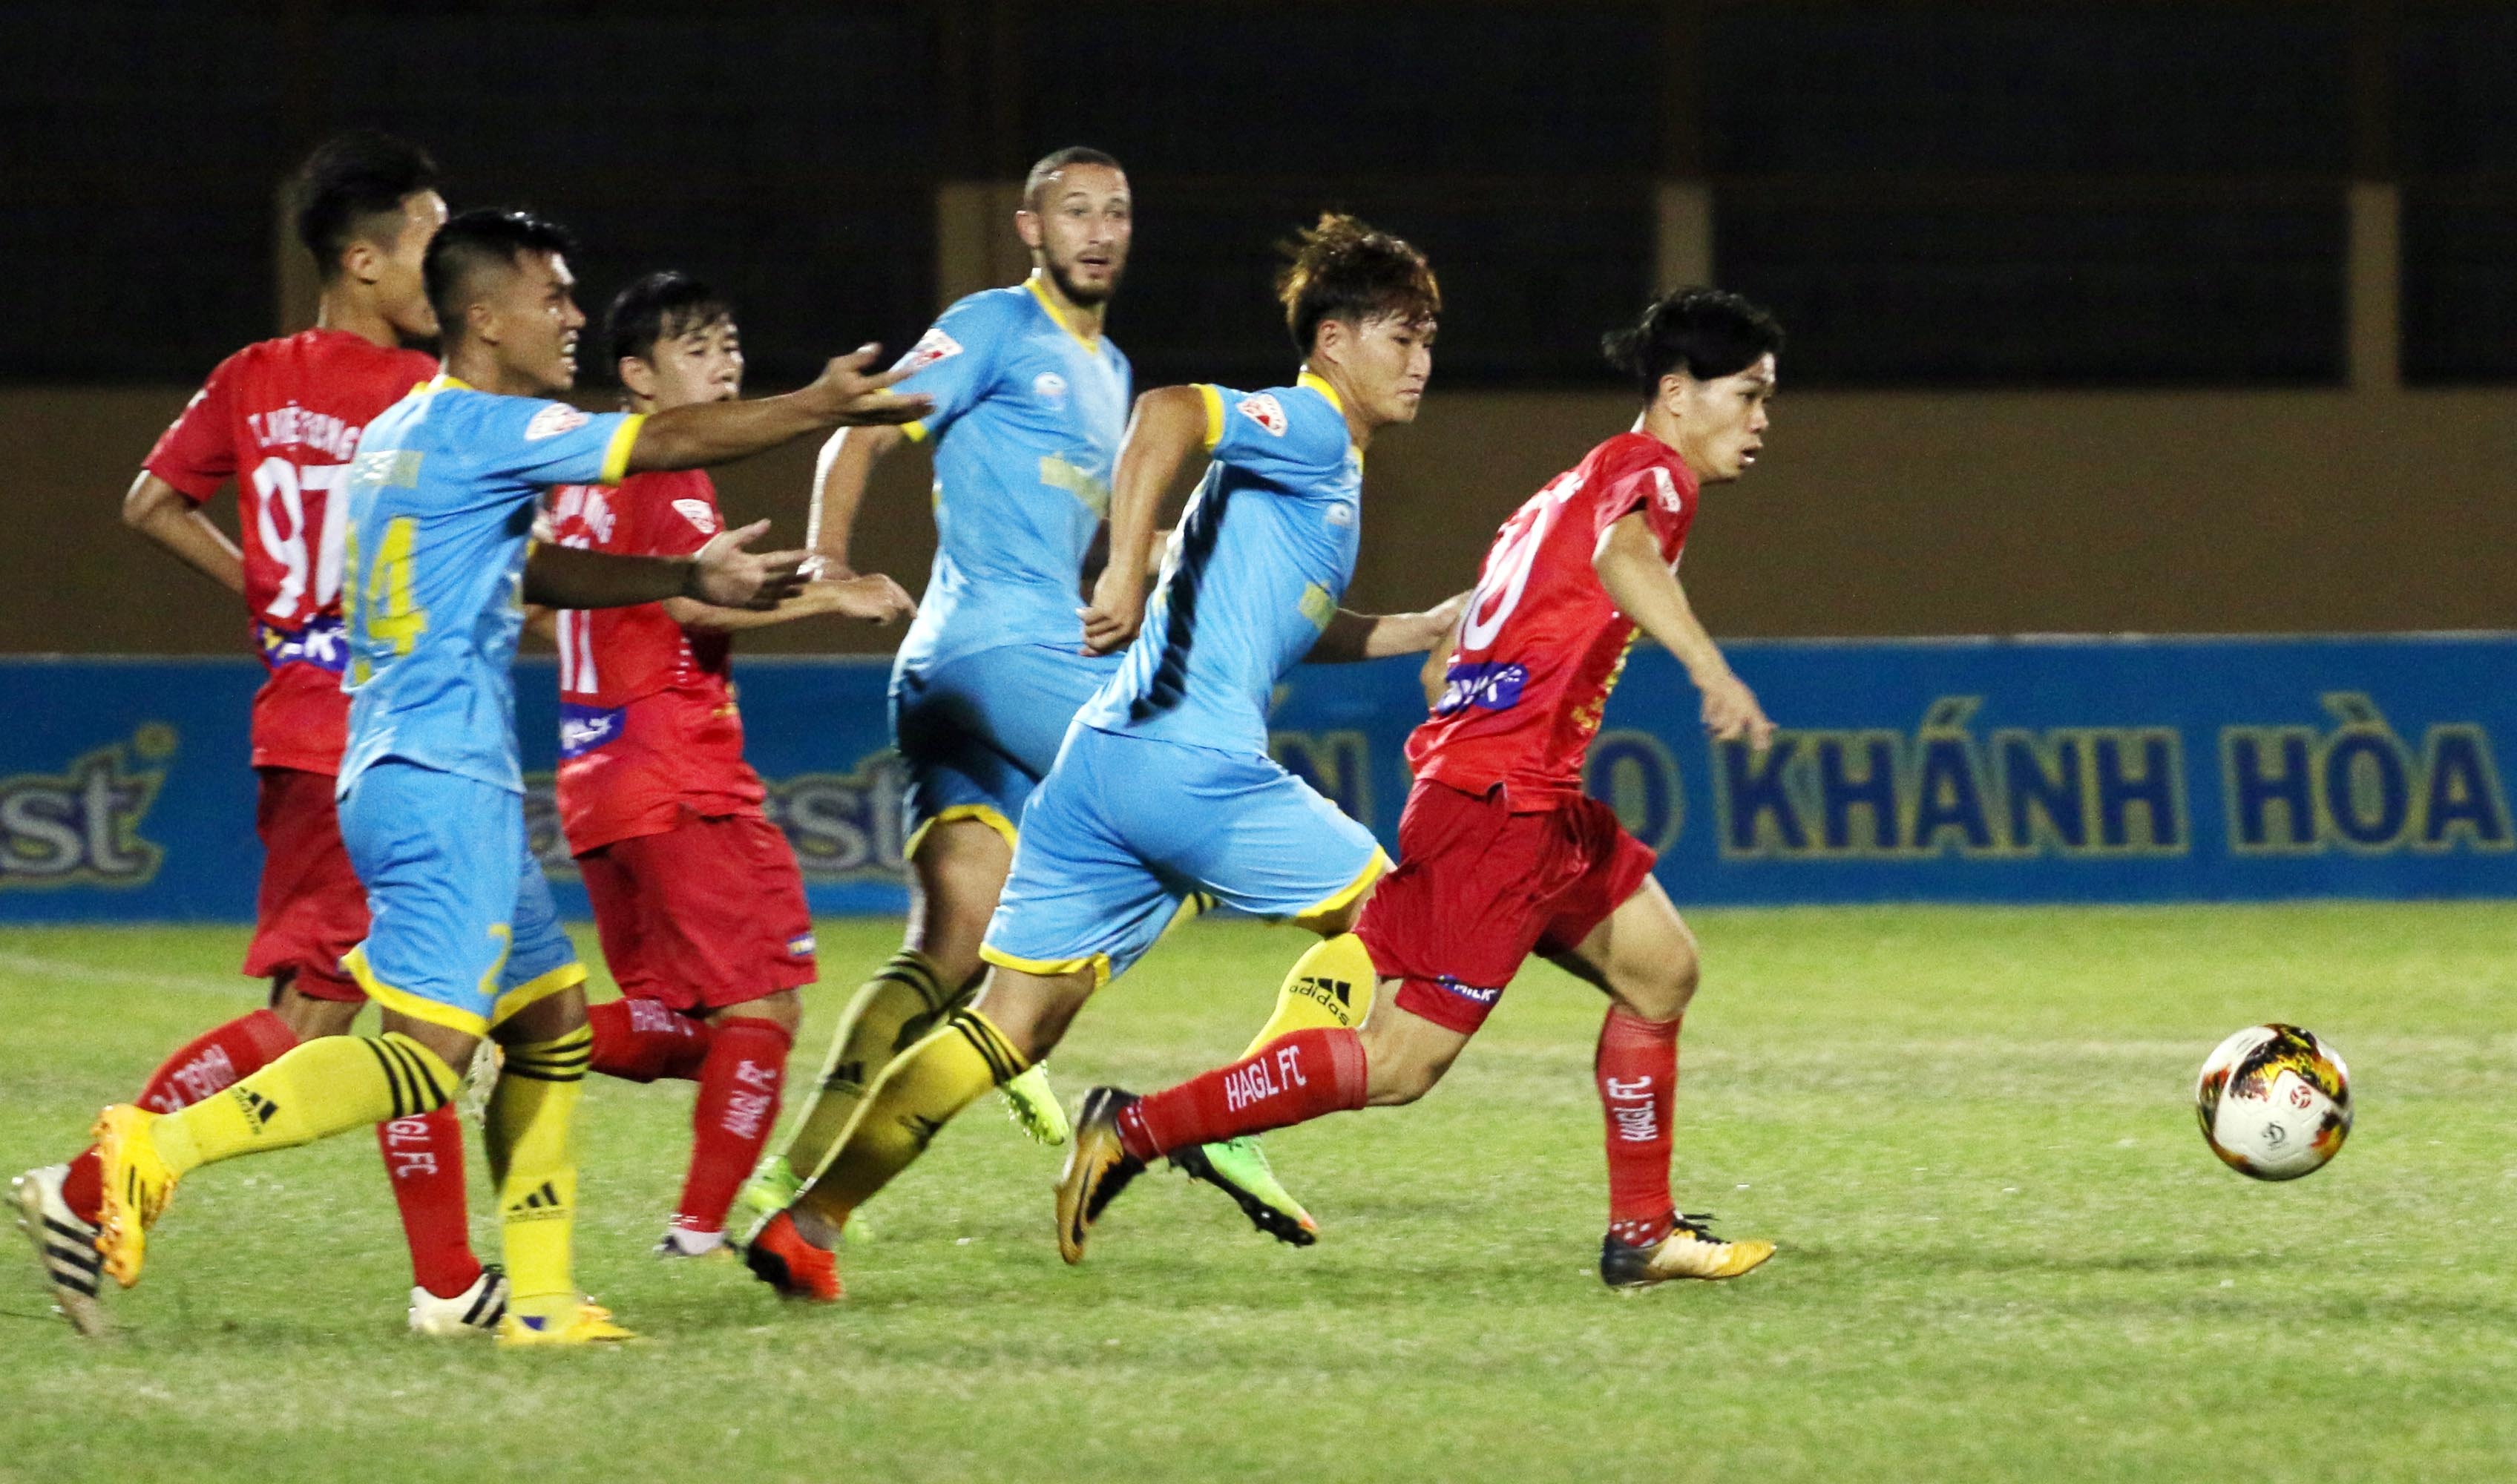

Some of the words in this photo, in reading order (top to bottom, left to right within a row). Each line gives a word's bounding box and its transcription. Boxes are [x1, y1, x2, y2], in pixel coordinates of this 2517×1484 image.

[252, 456, 349, 618] 97
[1714, 695, 2189, 856] KHÁNH
[2220, 692, 2516, 854] HÒA
[1289, 985, 1349, 1025] adidas
[1224, 1056, 1279, 1112] HAGL
[1276, 1045, 1307, 1091] FC
[1606, 1075, 1655, 1100] FC
[387, 1113, 431, 1147] GL
[1612, 1100, 1659, 1142] HAGL
[391, 1152, 439, 1178] FC
